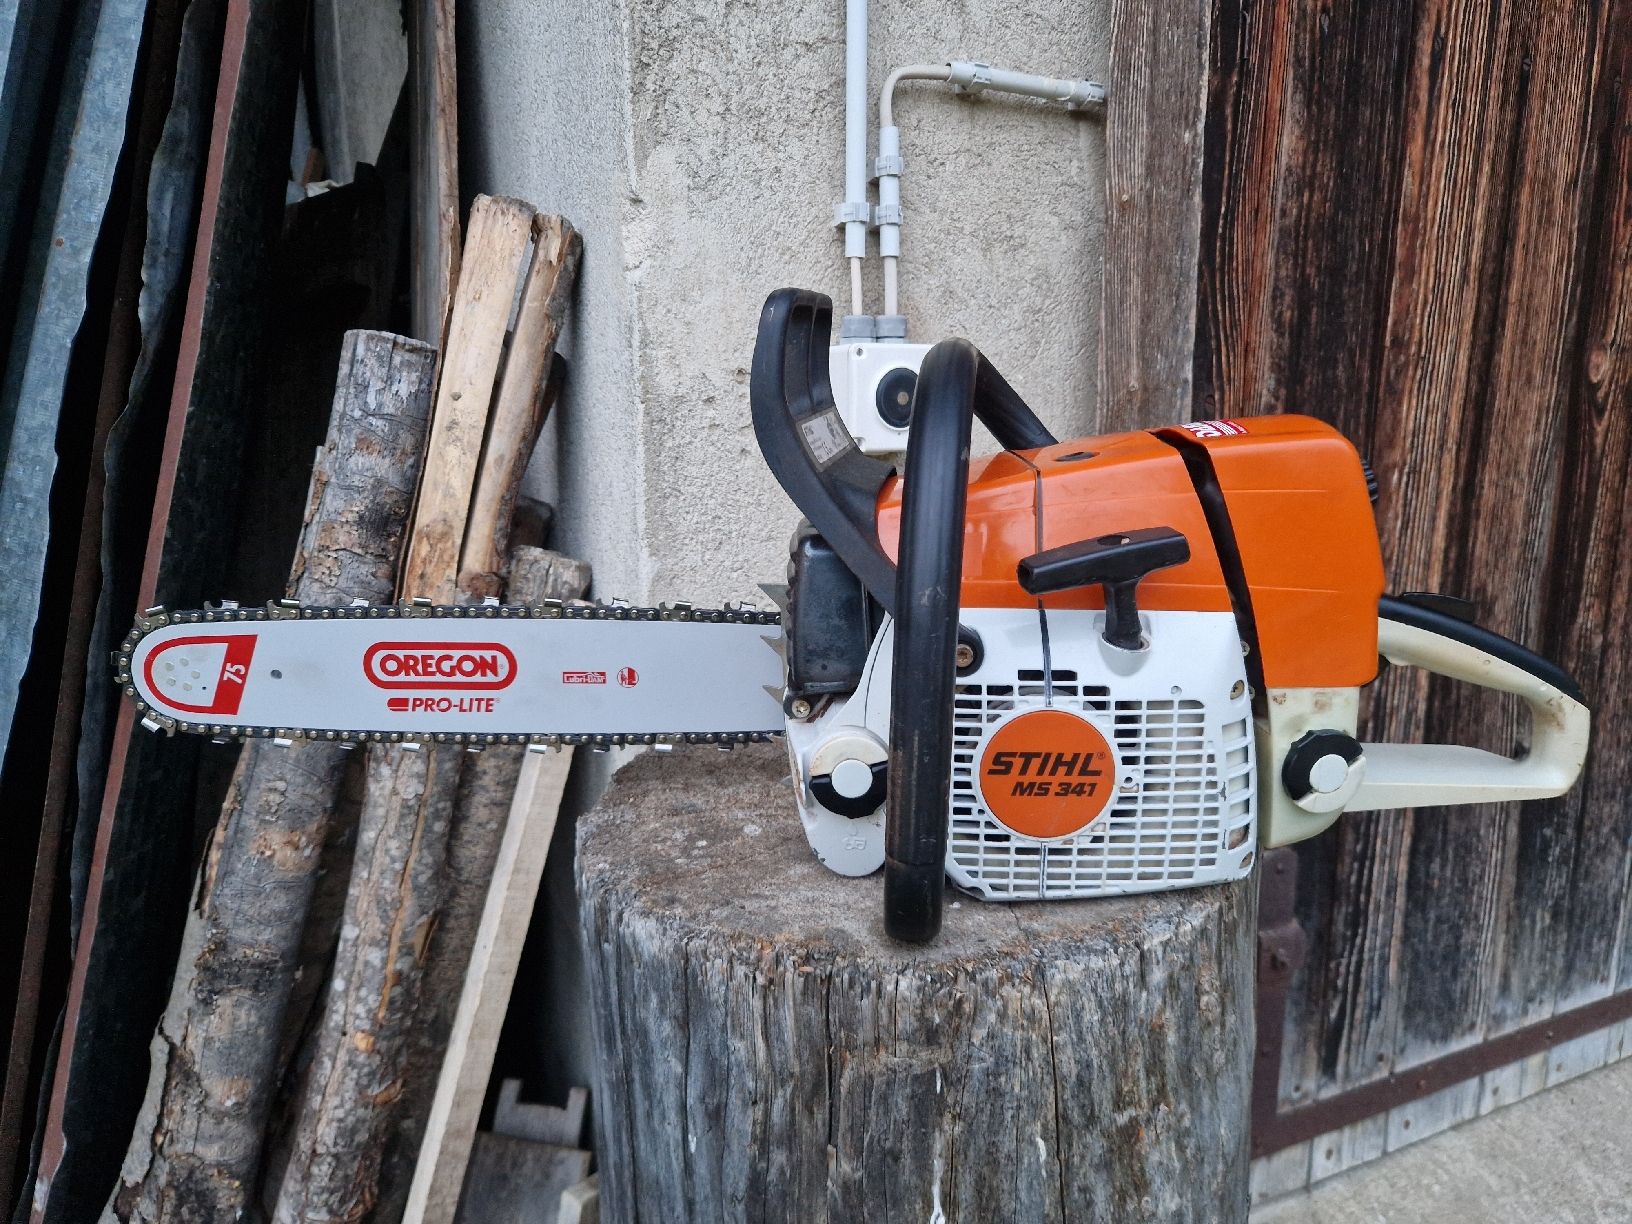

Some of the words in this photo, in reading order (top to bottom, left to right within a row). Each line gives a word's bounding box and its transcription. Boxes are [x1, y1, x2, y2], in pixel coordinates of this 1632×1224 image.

[223, 662, 246, 684] 75
[379, 653, 499, 677] OREGON
[411, 697, 496, 713] PRO-LITE
[987, 751, 1103, 777] STIHL
[1010, 781, 1052, 797] MS
[1054, 782, 1098, 797] 341
